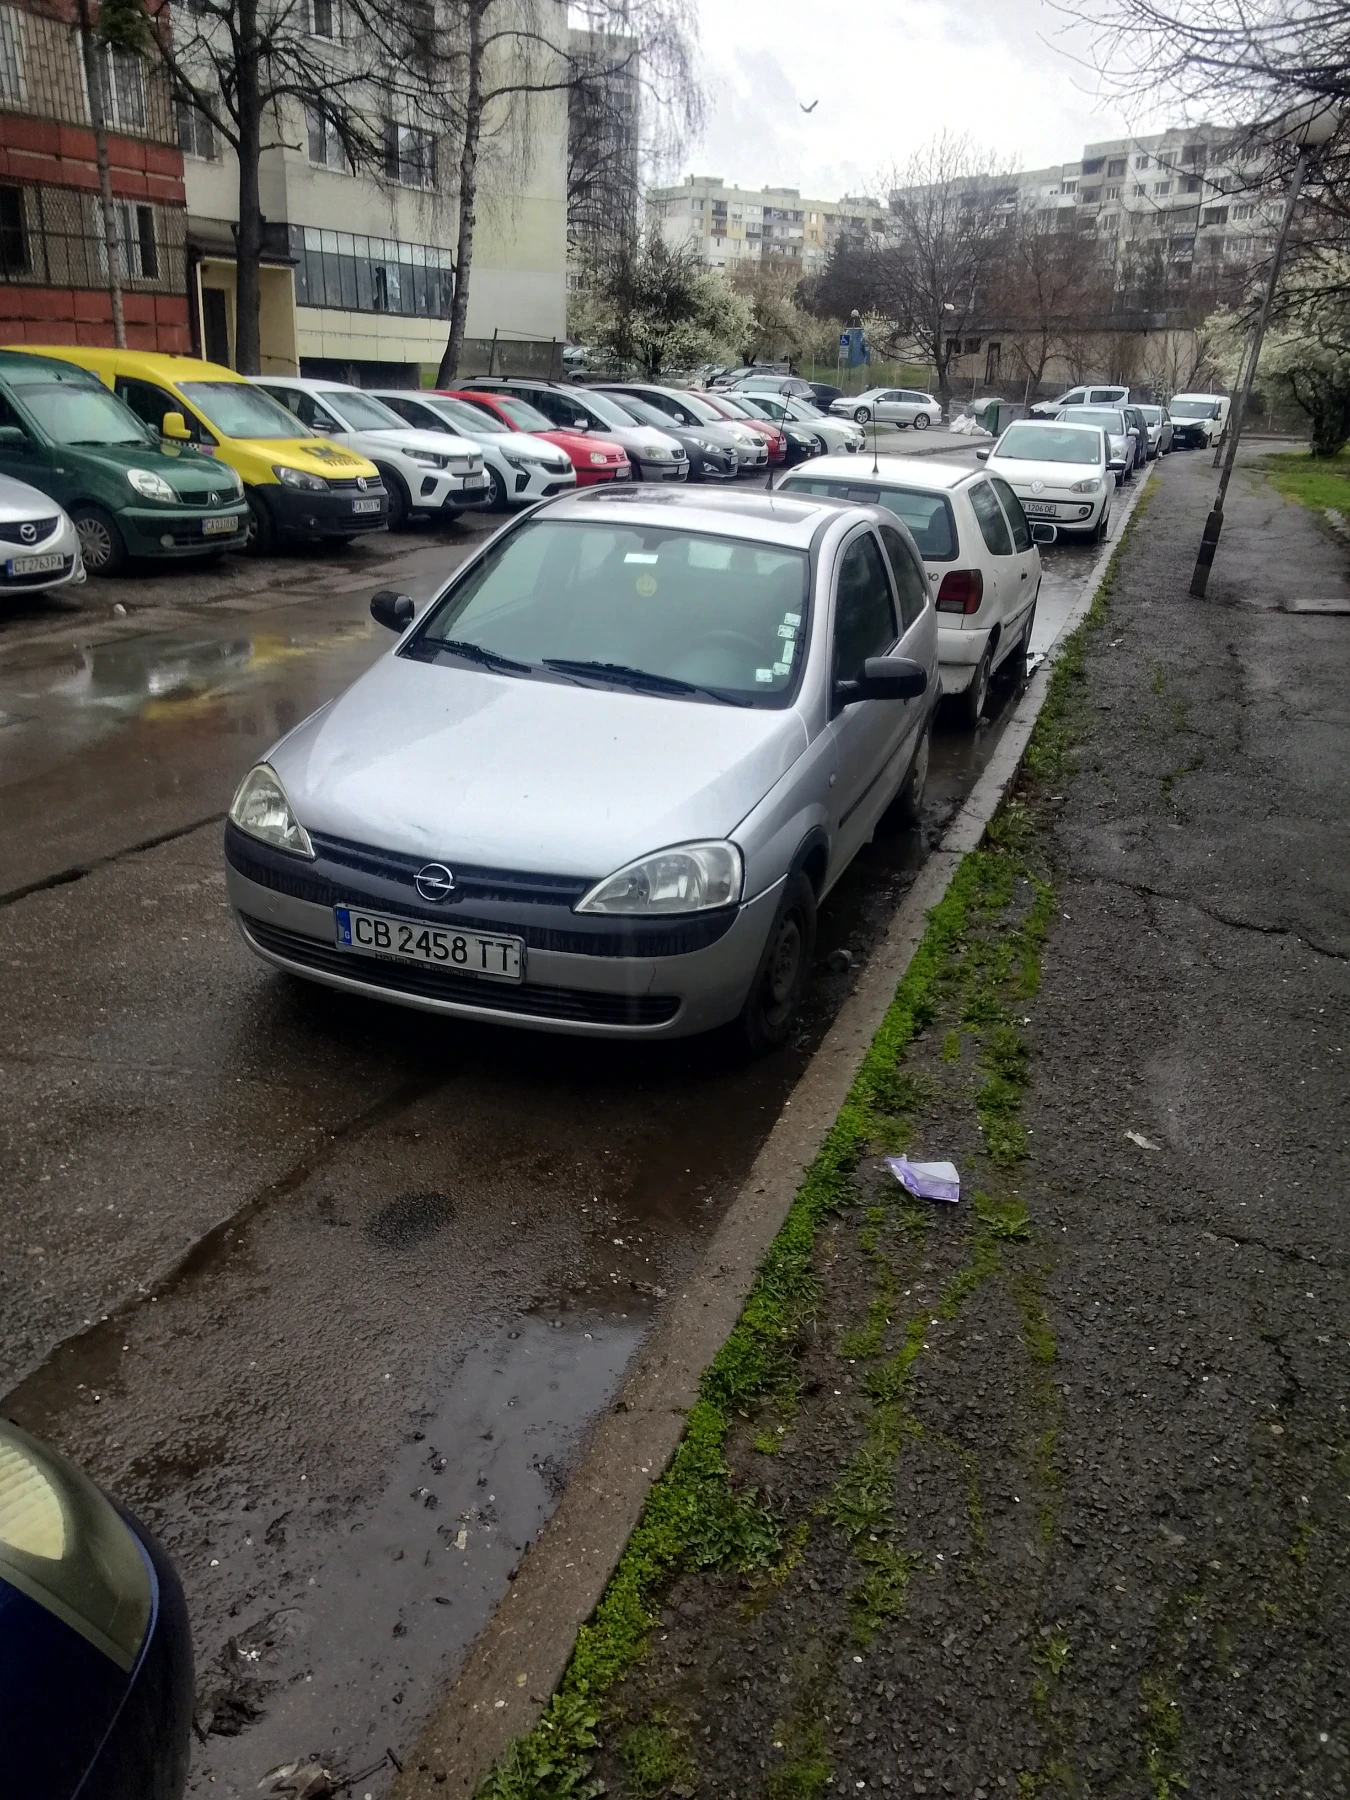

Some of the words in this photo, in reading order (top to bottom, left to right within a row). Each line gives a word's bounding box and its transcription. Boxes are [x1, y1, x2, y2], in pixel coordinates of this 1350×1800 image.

[1028, 504, 1043, 512] 1206
[15, 560, 26, 573] CT
[28, 556, 50, 572] 2763
[50, 555, 63, 567] PA
[355, 917, 391, 948] CB
[397, 925, 468, 964] 2458
[475, 938, 513, 971] TT
